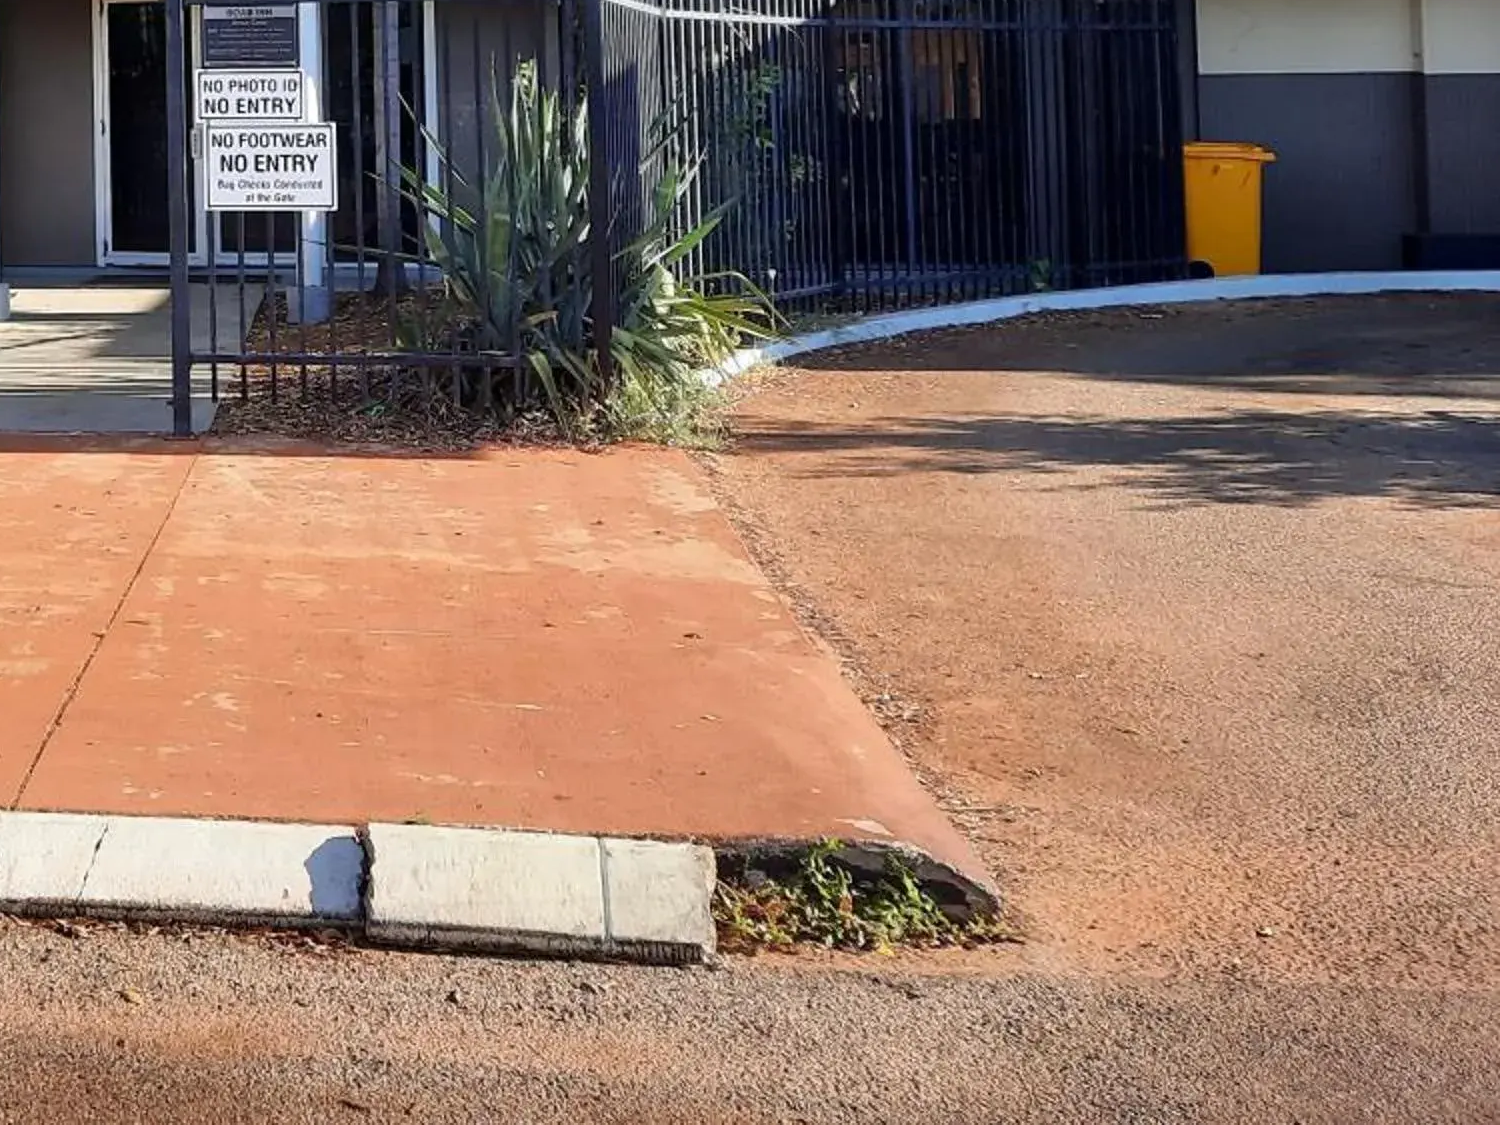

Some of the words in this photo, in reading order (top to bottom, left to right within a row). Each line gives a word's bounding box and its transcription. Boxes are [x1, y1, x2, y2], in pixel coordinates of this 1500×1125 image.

[203, 79, 224, 93] NO
[229, 79, 277, 93] PHOTO
[283, 79, 298, 93] ID
[204, 98, 229, 114] NO
[236, 97, 296, 114] ENTRY
[211, 133, 233, 148] NO
[239, 133, 328, 148] FOOTWEAR
[220, 154, 247, 172] NO
[255, 154, 318, 172] ENTRY
[238, 179, 270, 189] Checks
[258, 193, 271, 202] the
